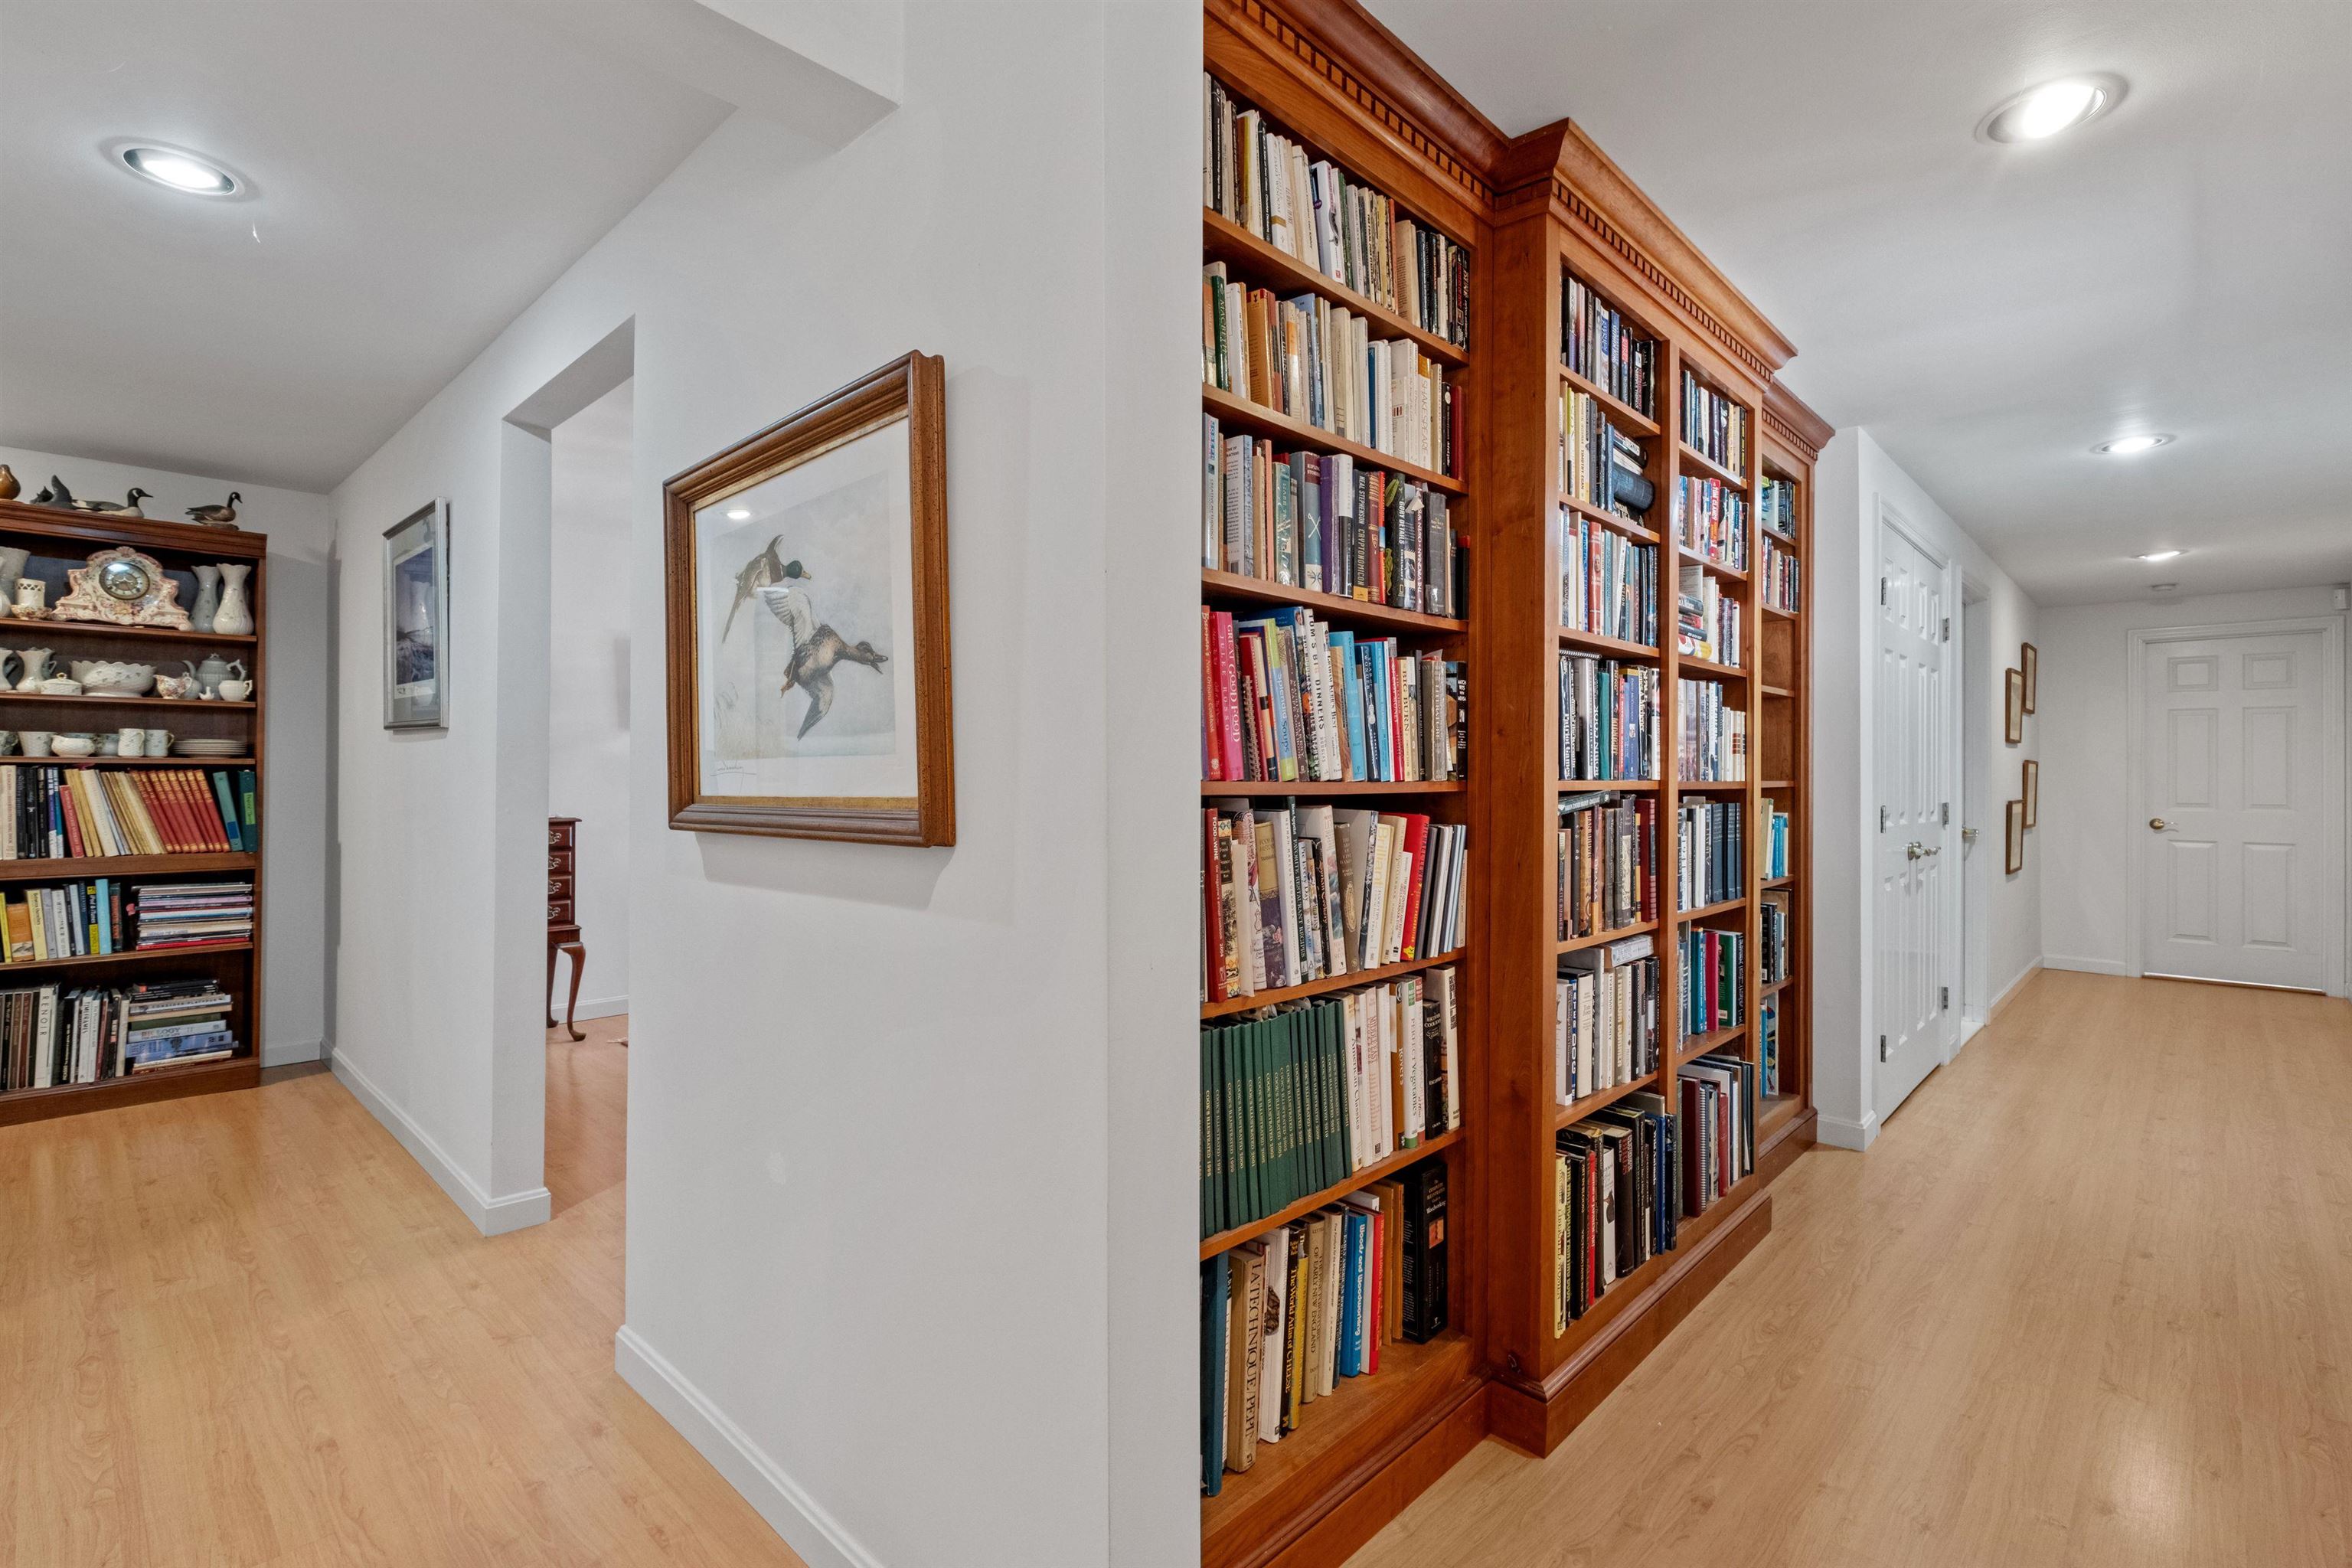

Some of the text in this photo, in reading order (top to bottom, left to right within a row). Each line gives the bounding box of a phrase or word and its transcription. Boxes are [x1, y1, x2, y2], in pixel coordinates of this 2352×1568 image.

[1278, 673, 1286, 718] Splendid
[1231, 706, 1240, 742] FOOD
[40, 996, 49, 1035] RENOIR
